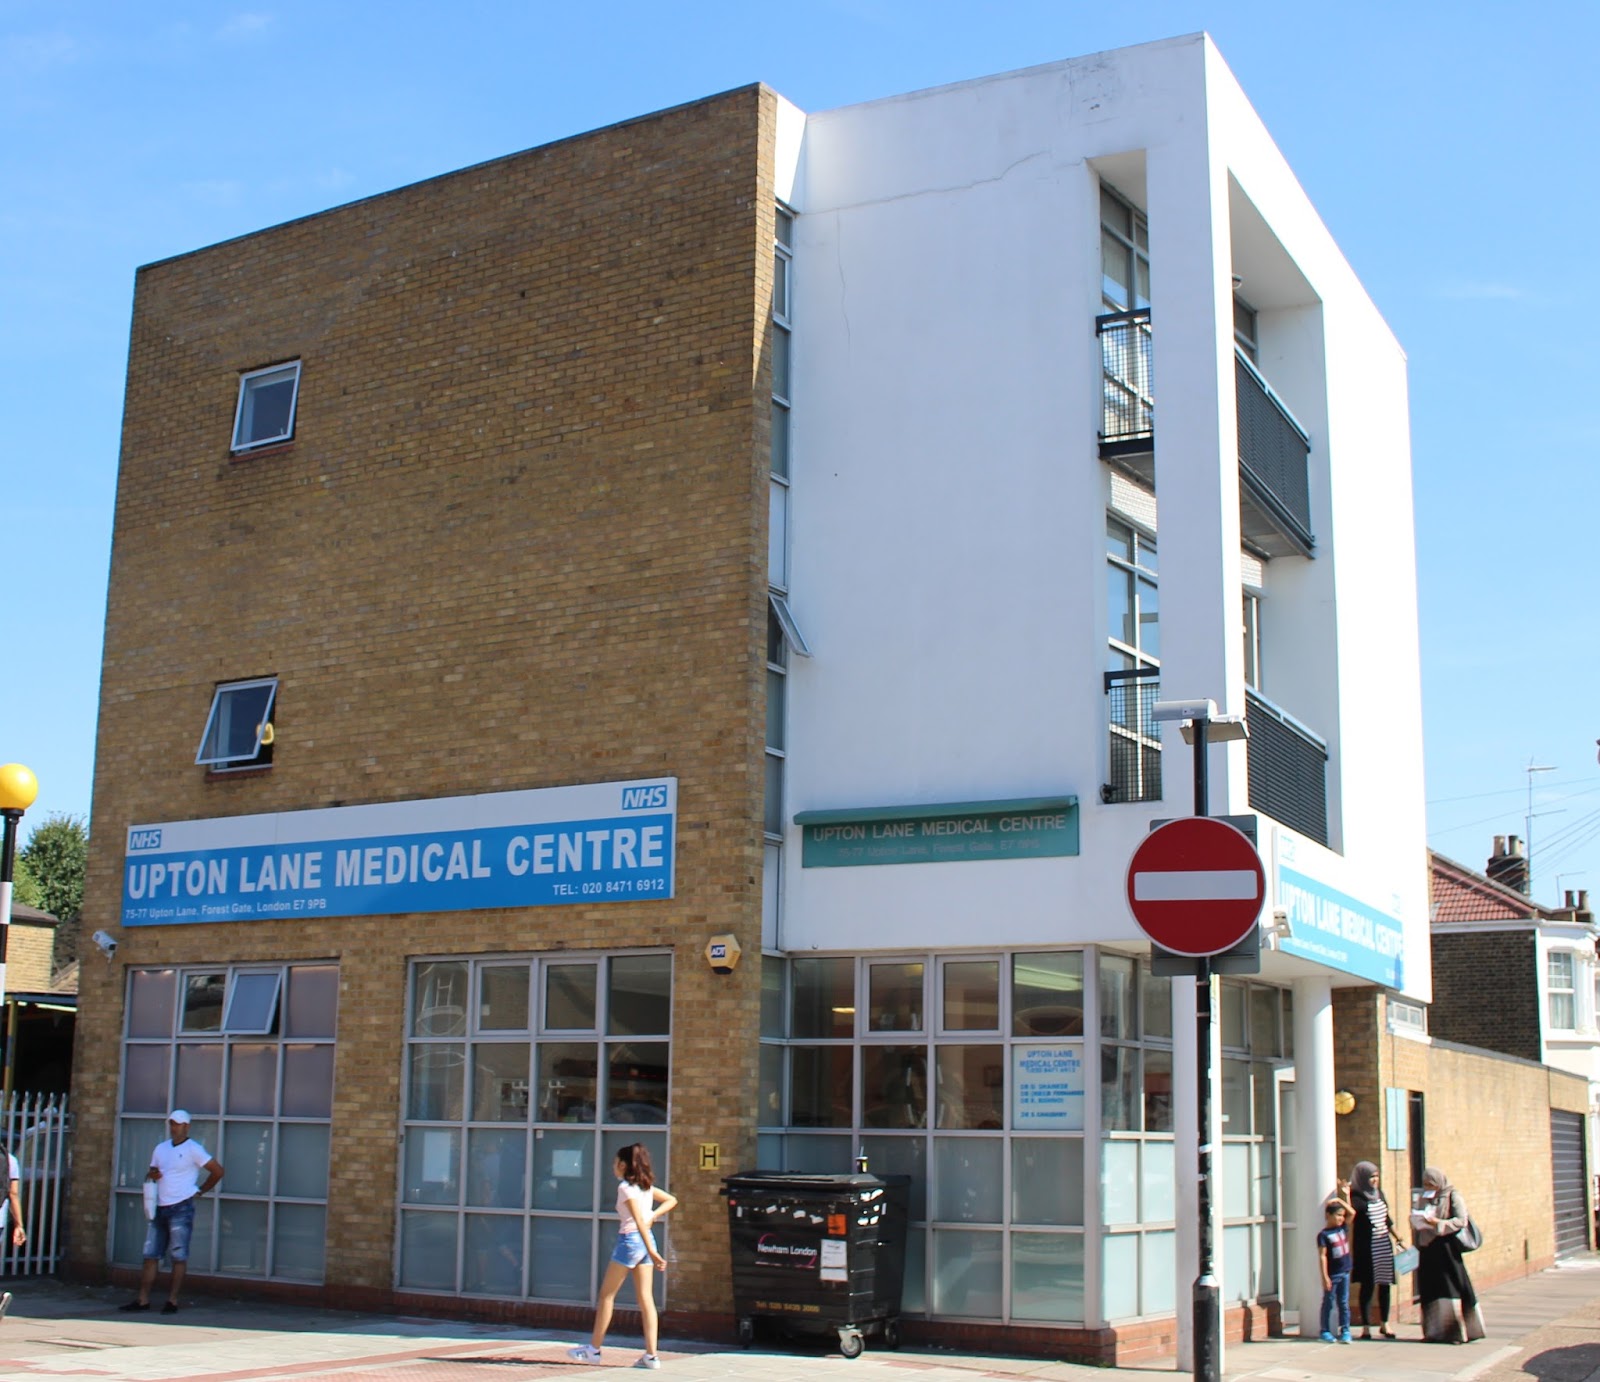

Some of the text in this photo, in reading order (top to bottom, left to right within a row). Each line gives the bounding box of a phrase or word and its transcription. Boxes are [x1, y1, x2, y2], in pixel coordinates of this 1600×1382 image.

[623, 787, 665, 809] NHS
[813, 814, 1066, 841] UPTON LANE MEDICAL CENTRE
[130, 830, 161, 849] NHS
[128, 826, 664, 900] UPTON LANE MEDICAL CENTRE
[553, 879, 664, 896] TEL: 020 8471 6912
[125, 908, 148, 919] 75-77
[149, 907, 174, 919] Upton
[202, 904, 229, 915] Forest
[257, 900, 291, 912] London
[293, 900, 305, 911] E7
[307, 899, 326, 910] 9PB
[1316, 895, 1341, 937] LANE
[711, 947, 726, 956] ADT
[1020, 1059, 1081, 1068] MEDICAL CENTRE
[1027, 1050, 1052, 1058] UPTON
[702, 1145, 717, 1167] H
[757, 1243, 789, 1255] Newham
[790, 1245, 817, 1257] London
